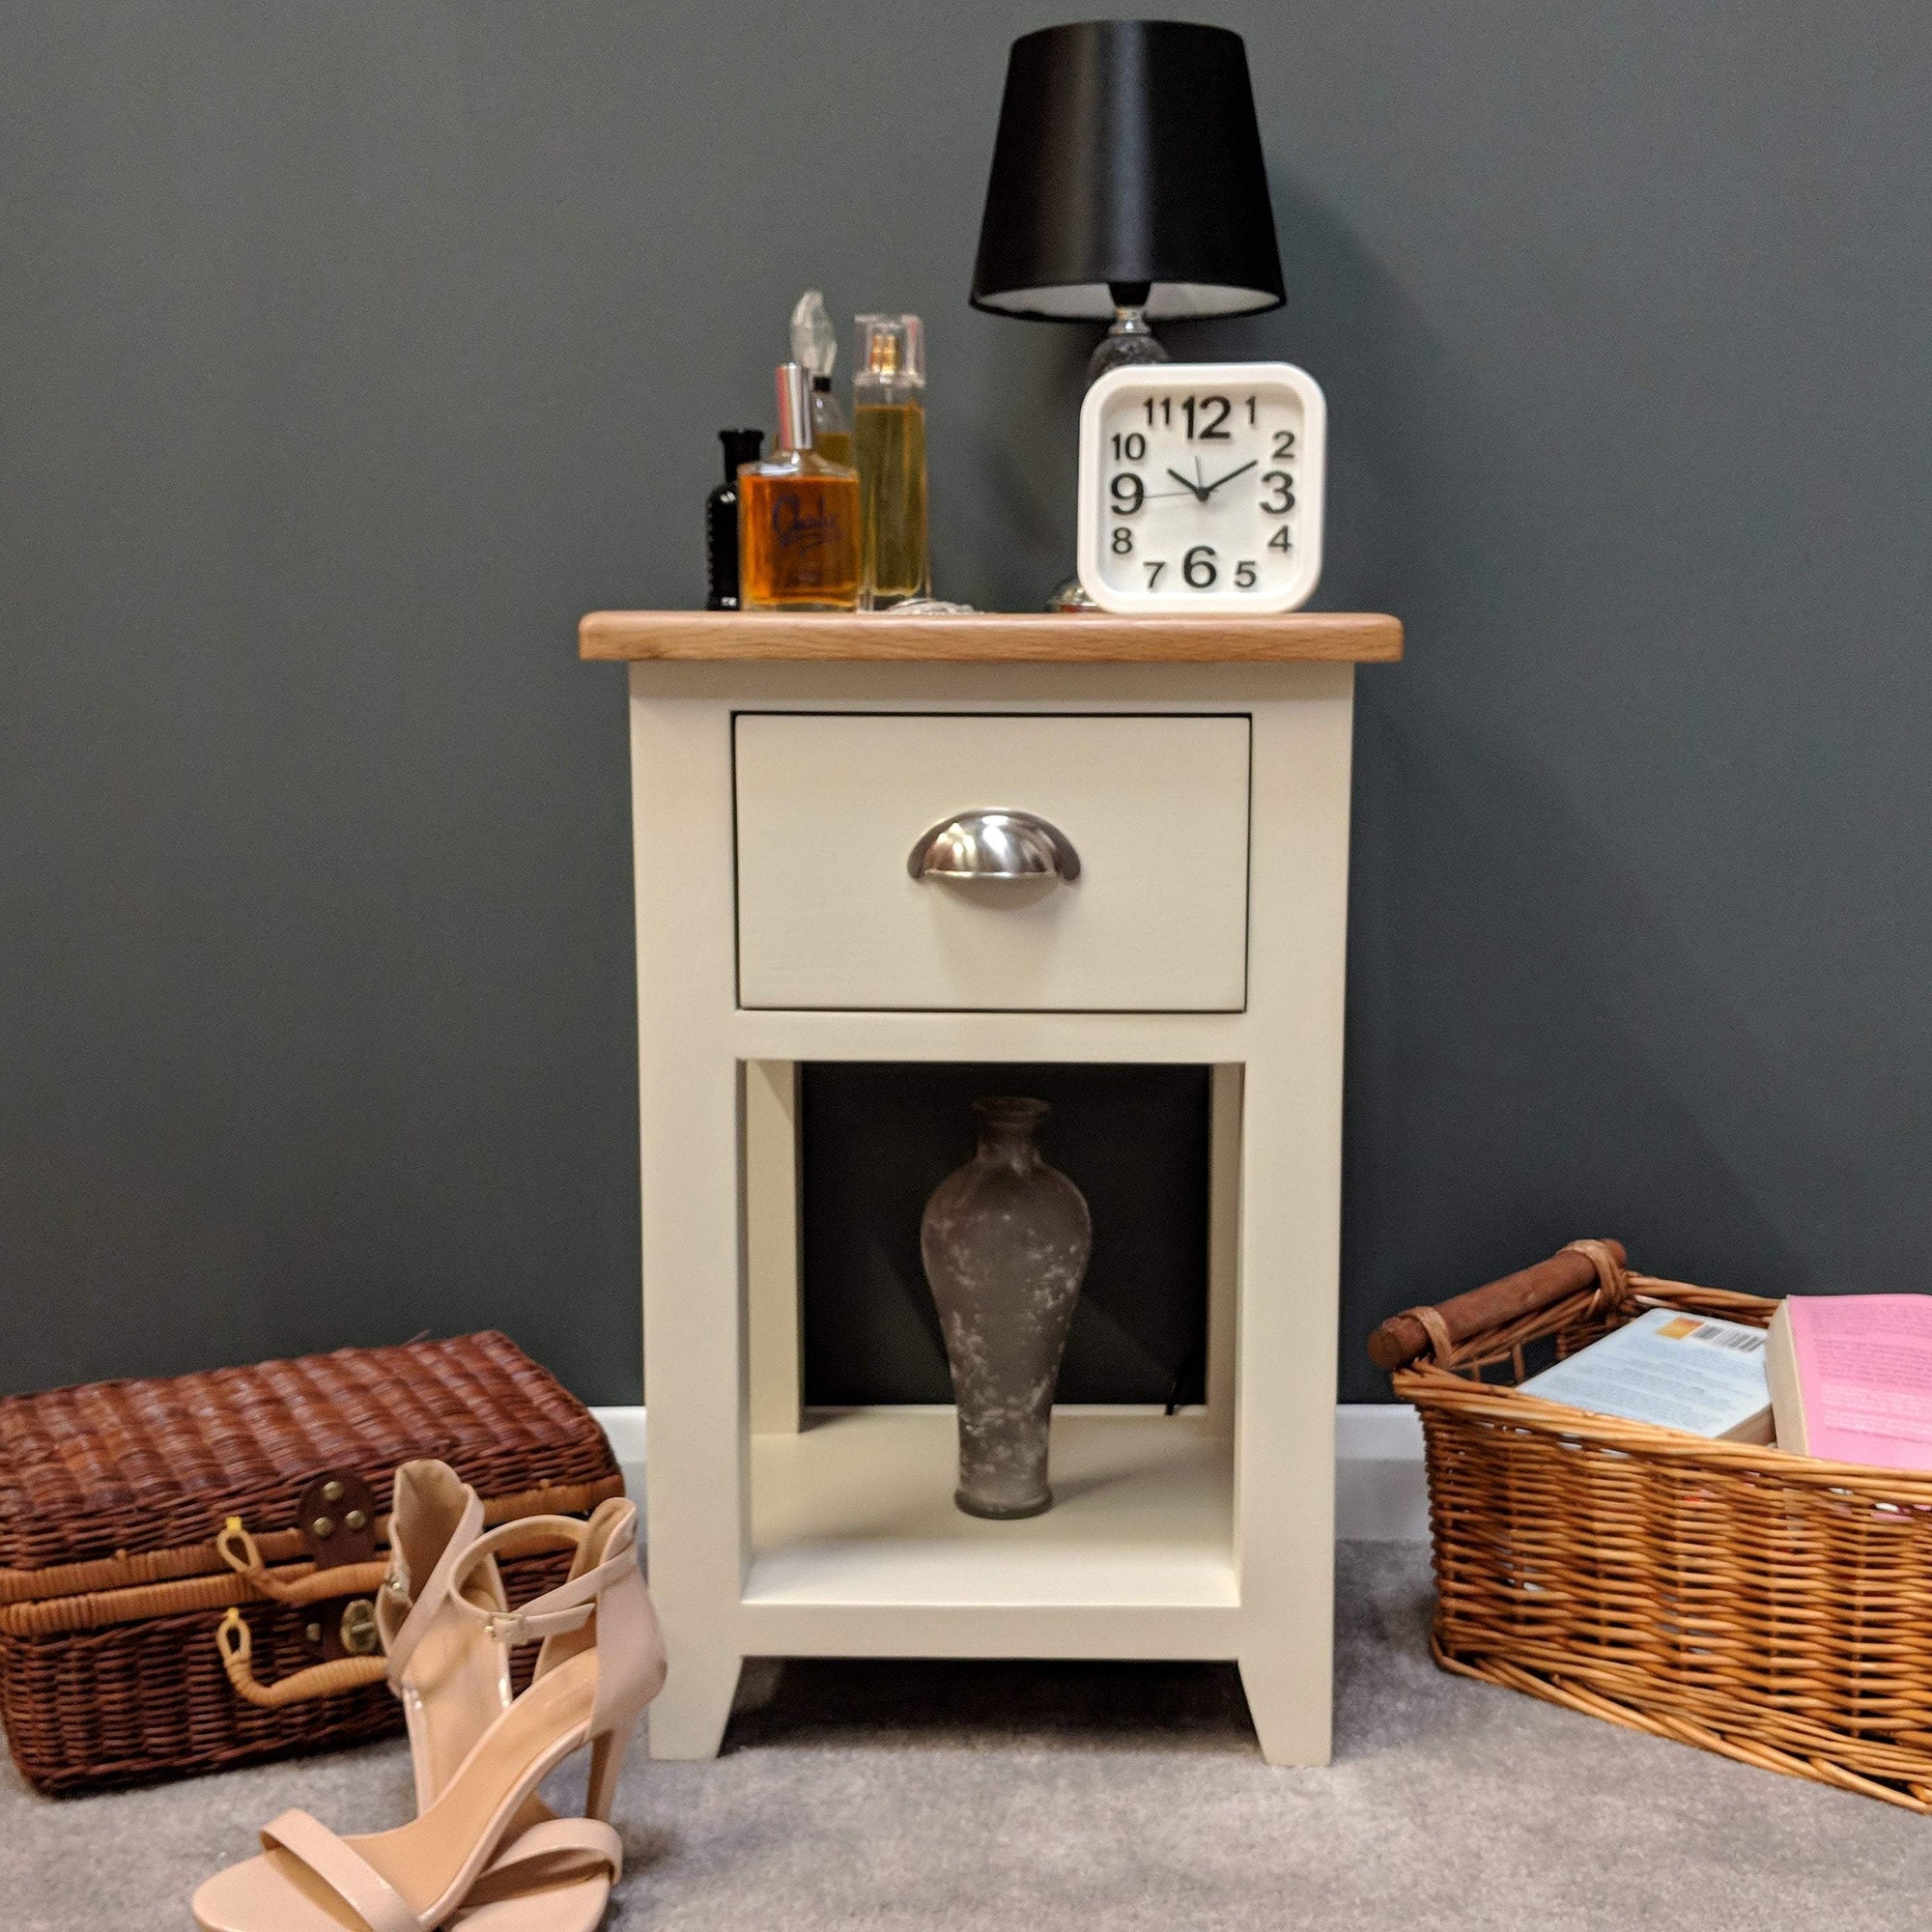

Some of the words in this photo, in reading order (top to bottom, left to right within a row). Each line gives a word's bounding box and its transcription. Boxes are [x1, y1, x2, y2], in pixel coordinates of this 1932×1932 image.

[1143, 397, 1171, 425] 11
[1182, 396, 1232, 440] 12
[1245, 395, 1257, 425] 1
[1111, 433, 1147, 461] 10
[1271, 431, 1296, 460] 2
[1111, 472, 1145, 515] 9
[1260, 470, 1295, 516] 3
[1111, 527, 1133, 555] 8
[1267, 526, 1293, 554] 4
[1143, 561, 1166, 589] 7
[1182, 545, 1217, 589] 6
[1234, 560, 1258, 589] 5
